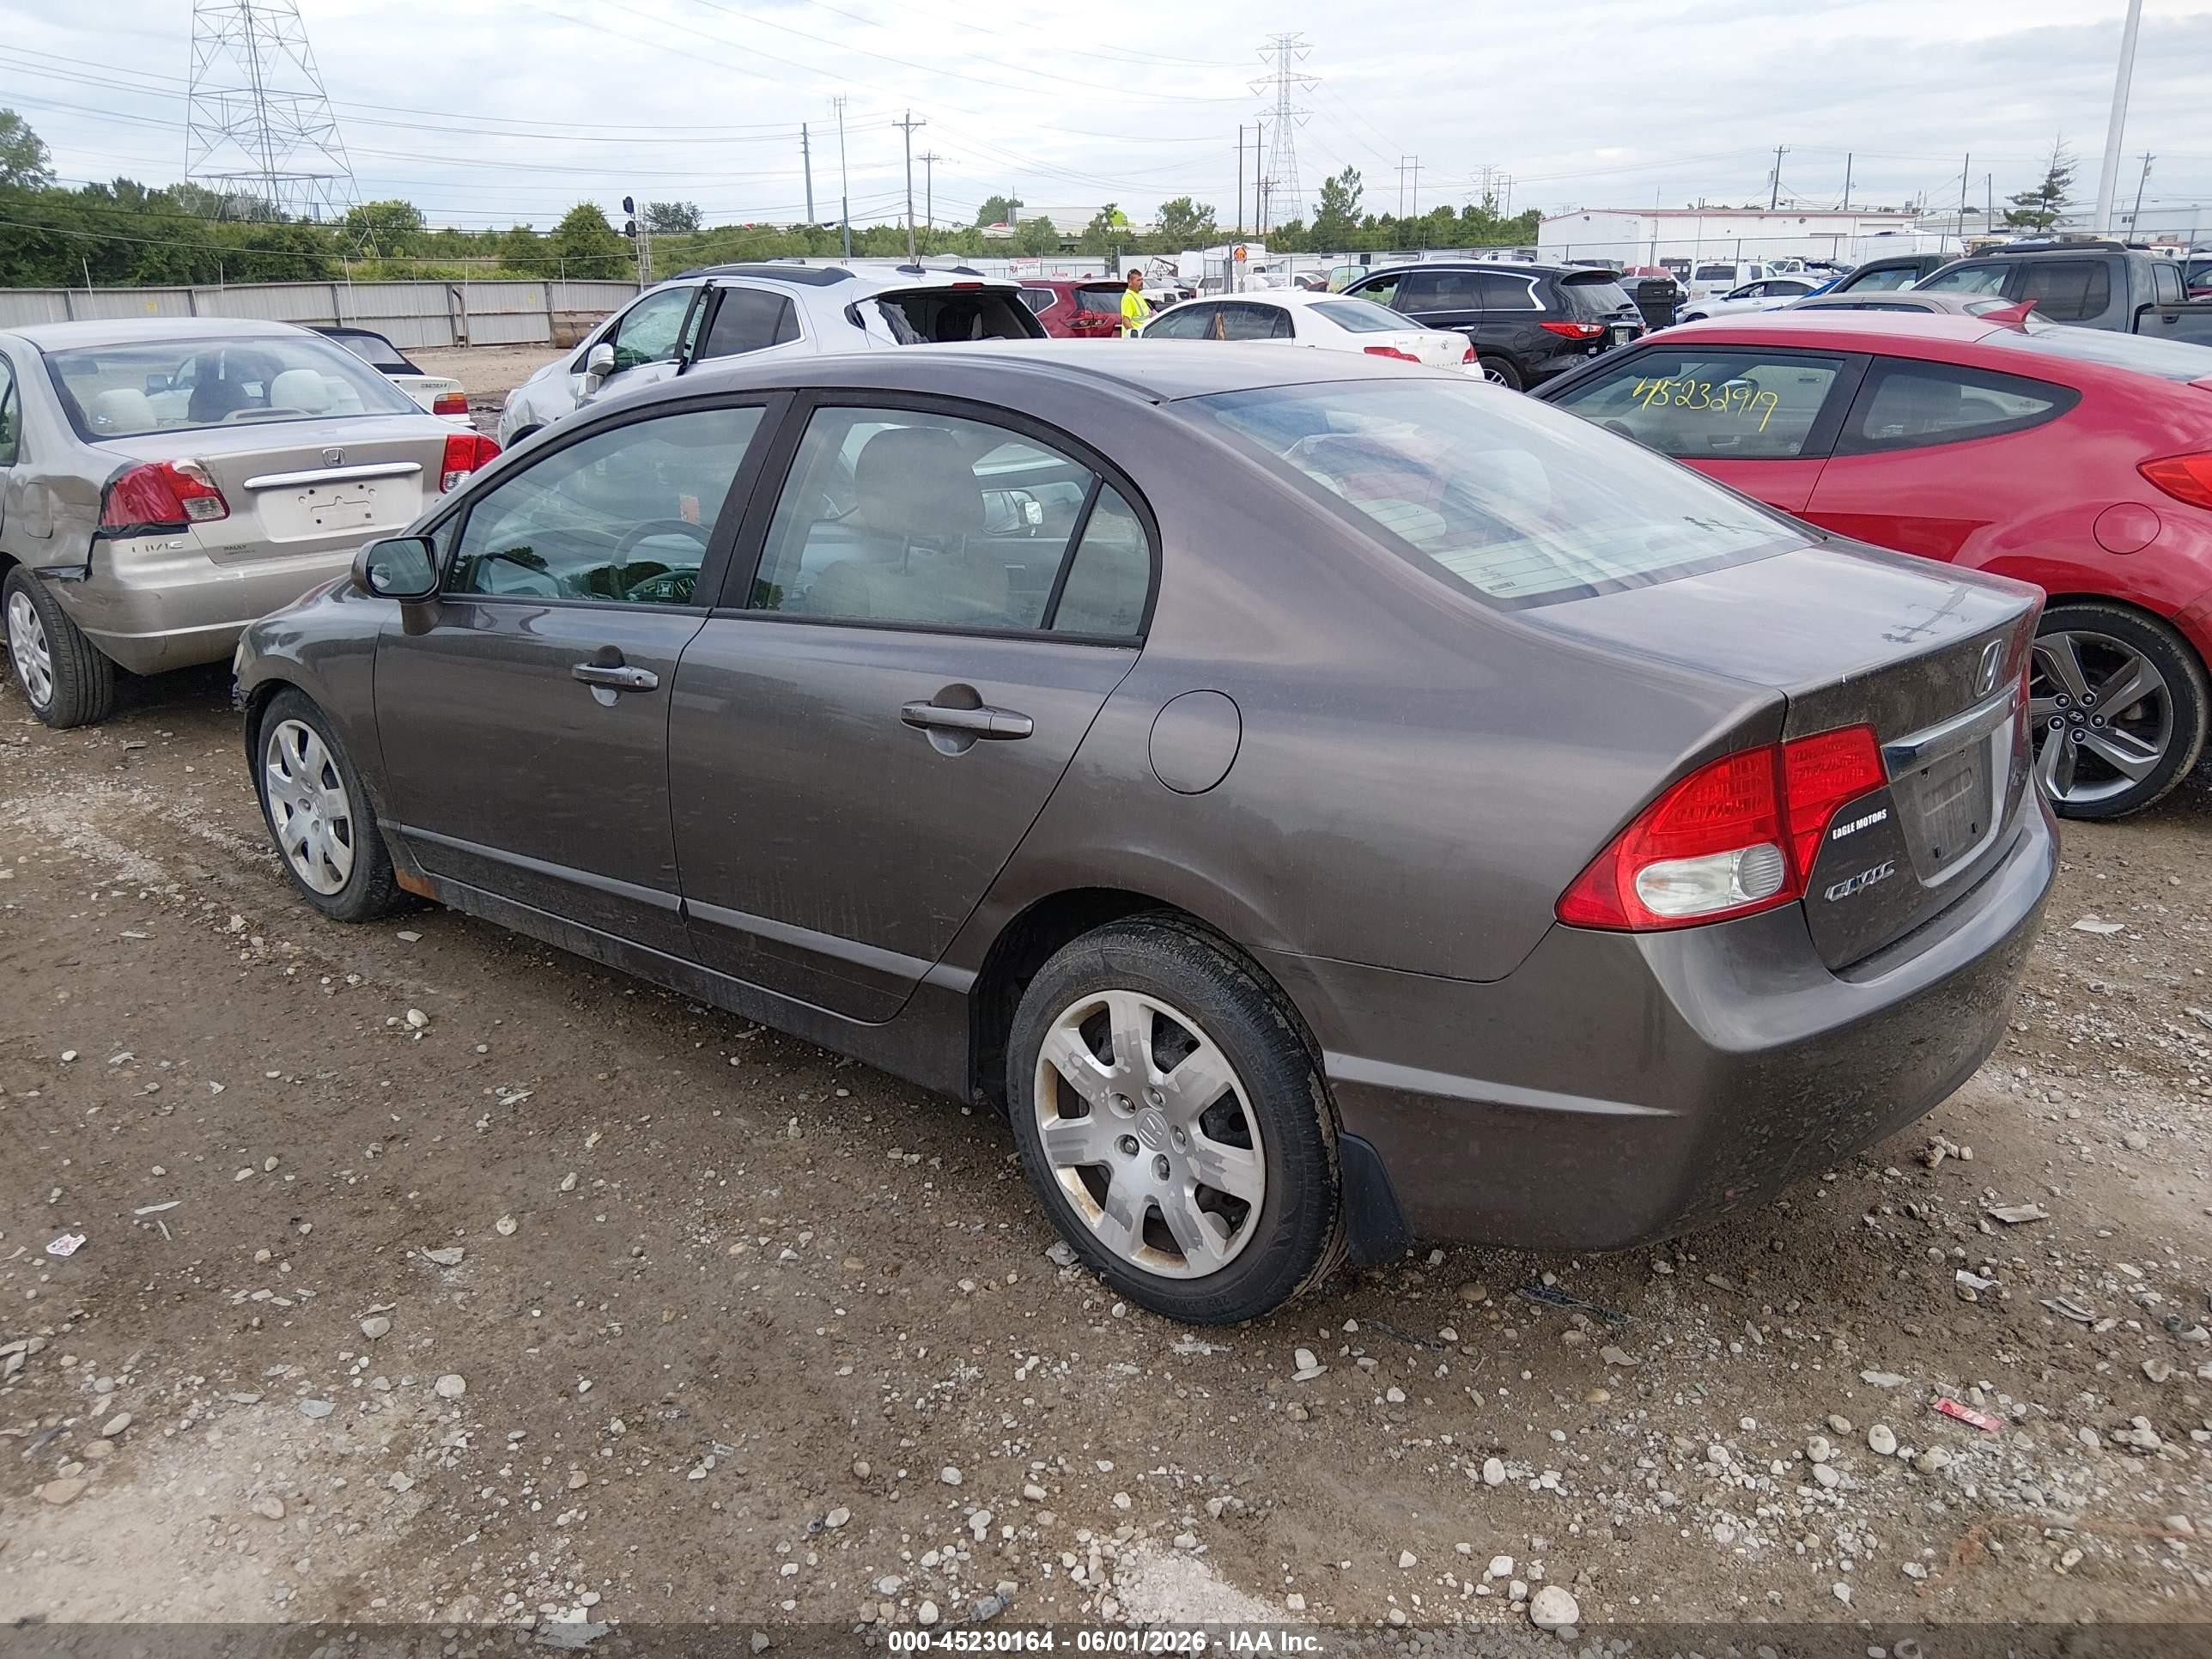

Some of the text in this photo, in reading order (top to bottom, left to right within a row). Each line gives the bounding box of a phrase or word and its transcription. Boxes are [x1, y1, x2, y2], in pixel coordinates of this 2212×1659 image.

[1632, 376, 1778, 433] 45232919
[1832, 809, 1887, 840] EAGLE MOTORS
